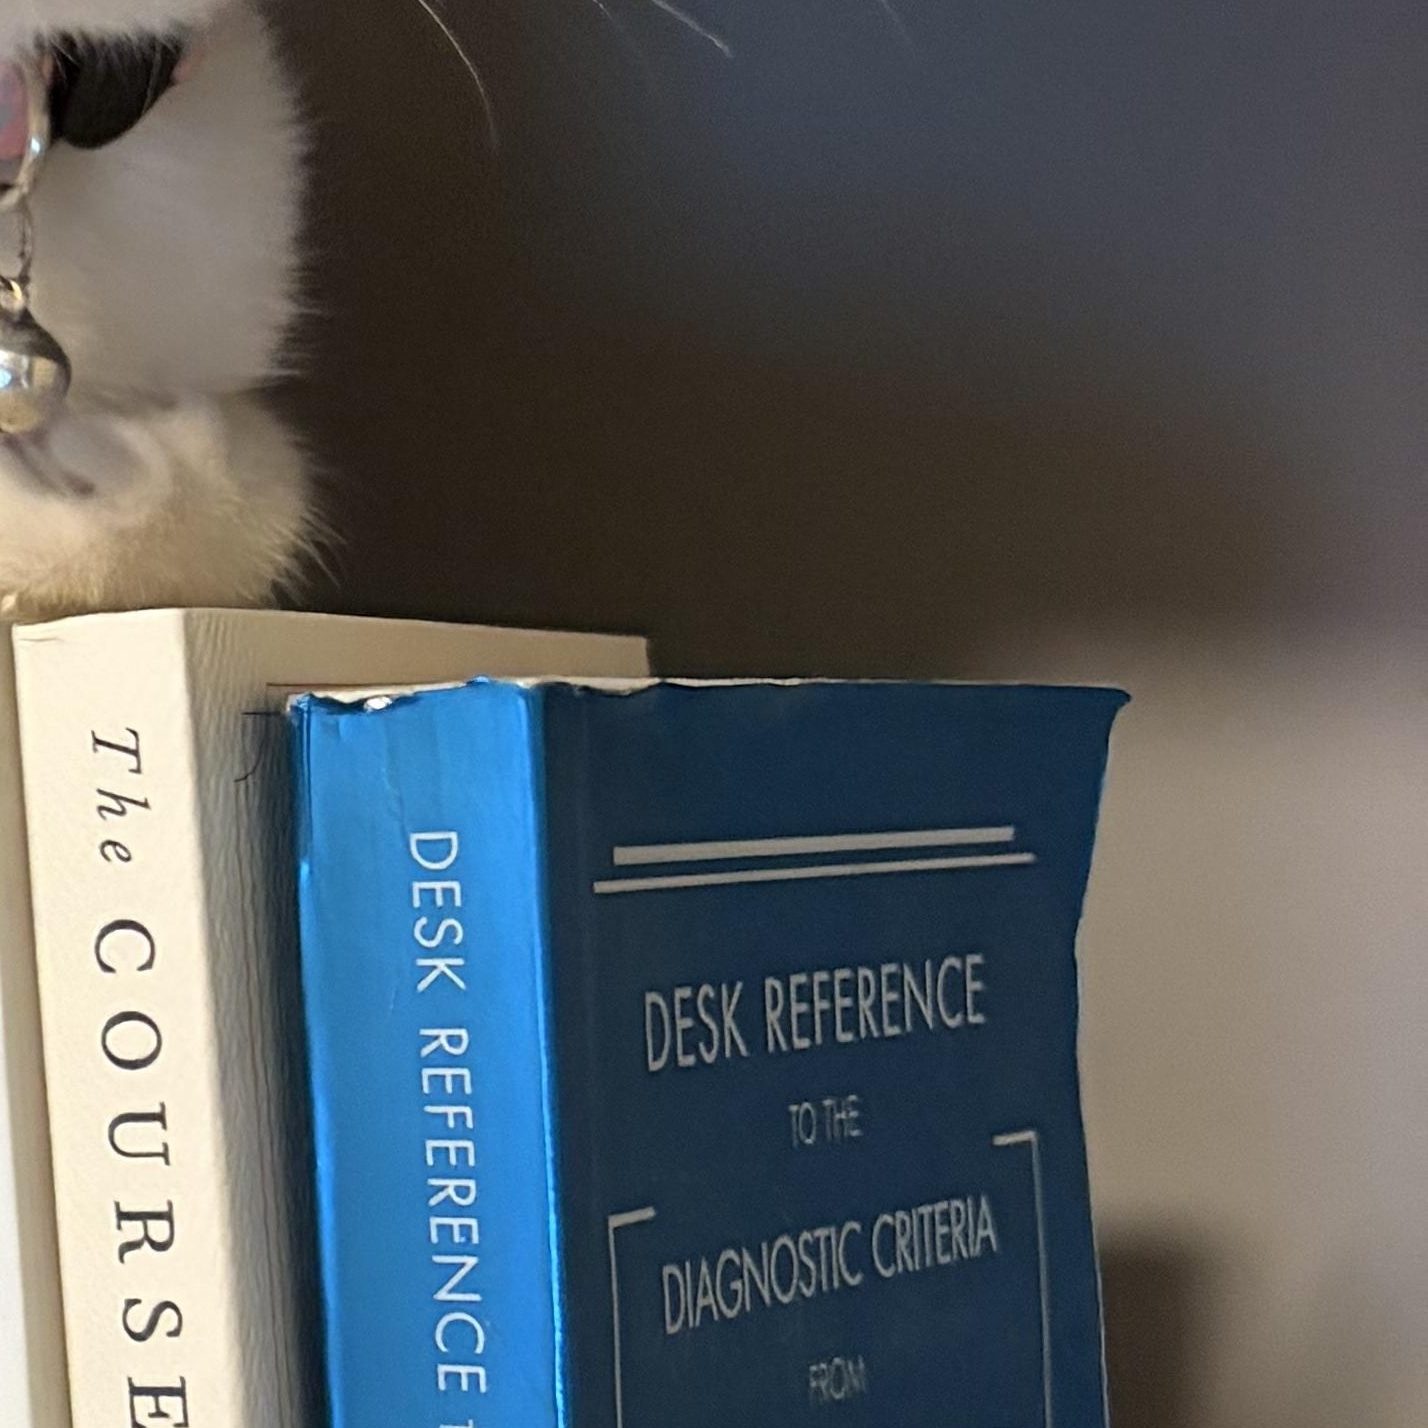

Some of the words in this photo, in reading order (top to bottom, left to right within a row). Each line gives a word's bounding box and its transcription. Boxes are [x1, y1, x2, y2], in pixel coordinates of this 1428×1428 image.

[91, 728, 150, 864] The
[408, 830, 467, 994] DESK
[645, 981, 749, 1072] DESK
[764, 953, 986, 1053] REFERENCE
[789, 1100, 817, 1148] TO
[822, 1094, 863, 1140] THE
[419, 1028, 487, 1394] REFERENCE
[662, 1220, 863, 1335] DIAGNOSTIC
[872, 1195, 997, 1280] CRITERIA
[808, 1356, 867, 1406] FROM
